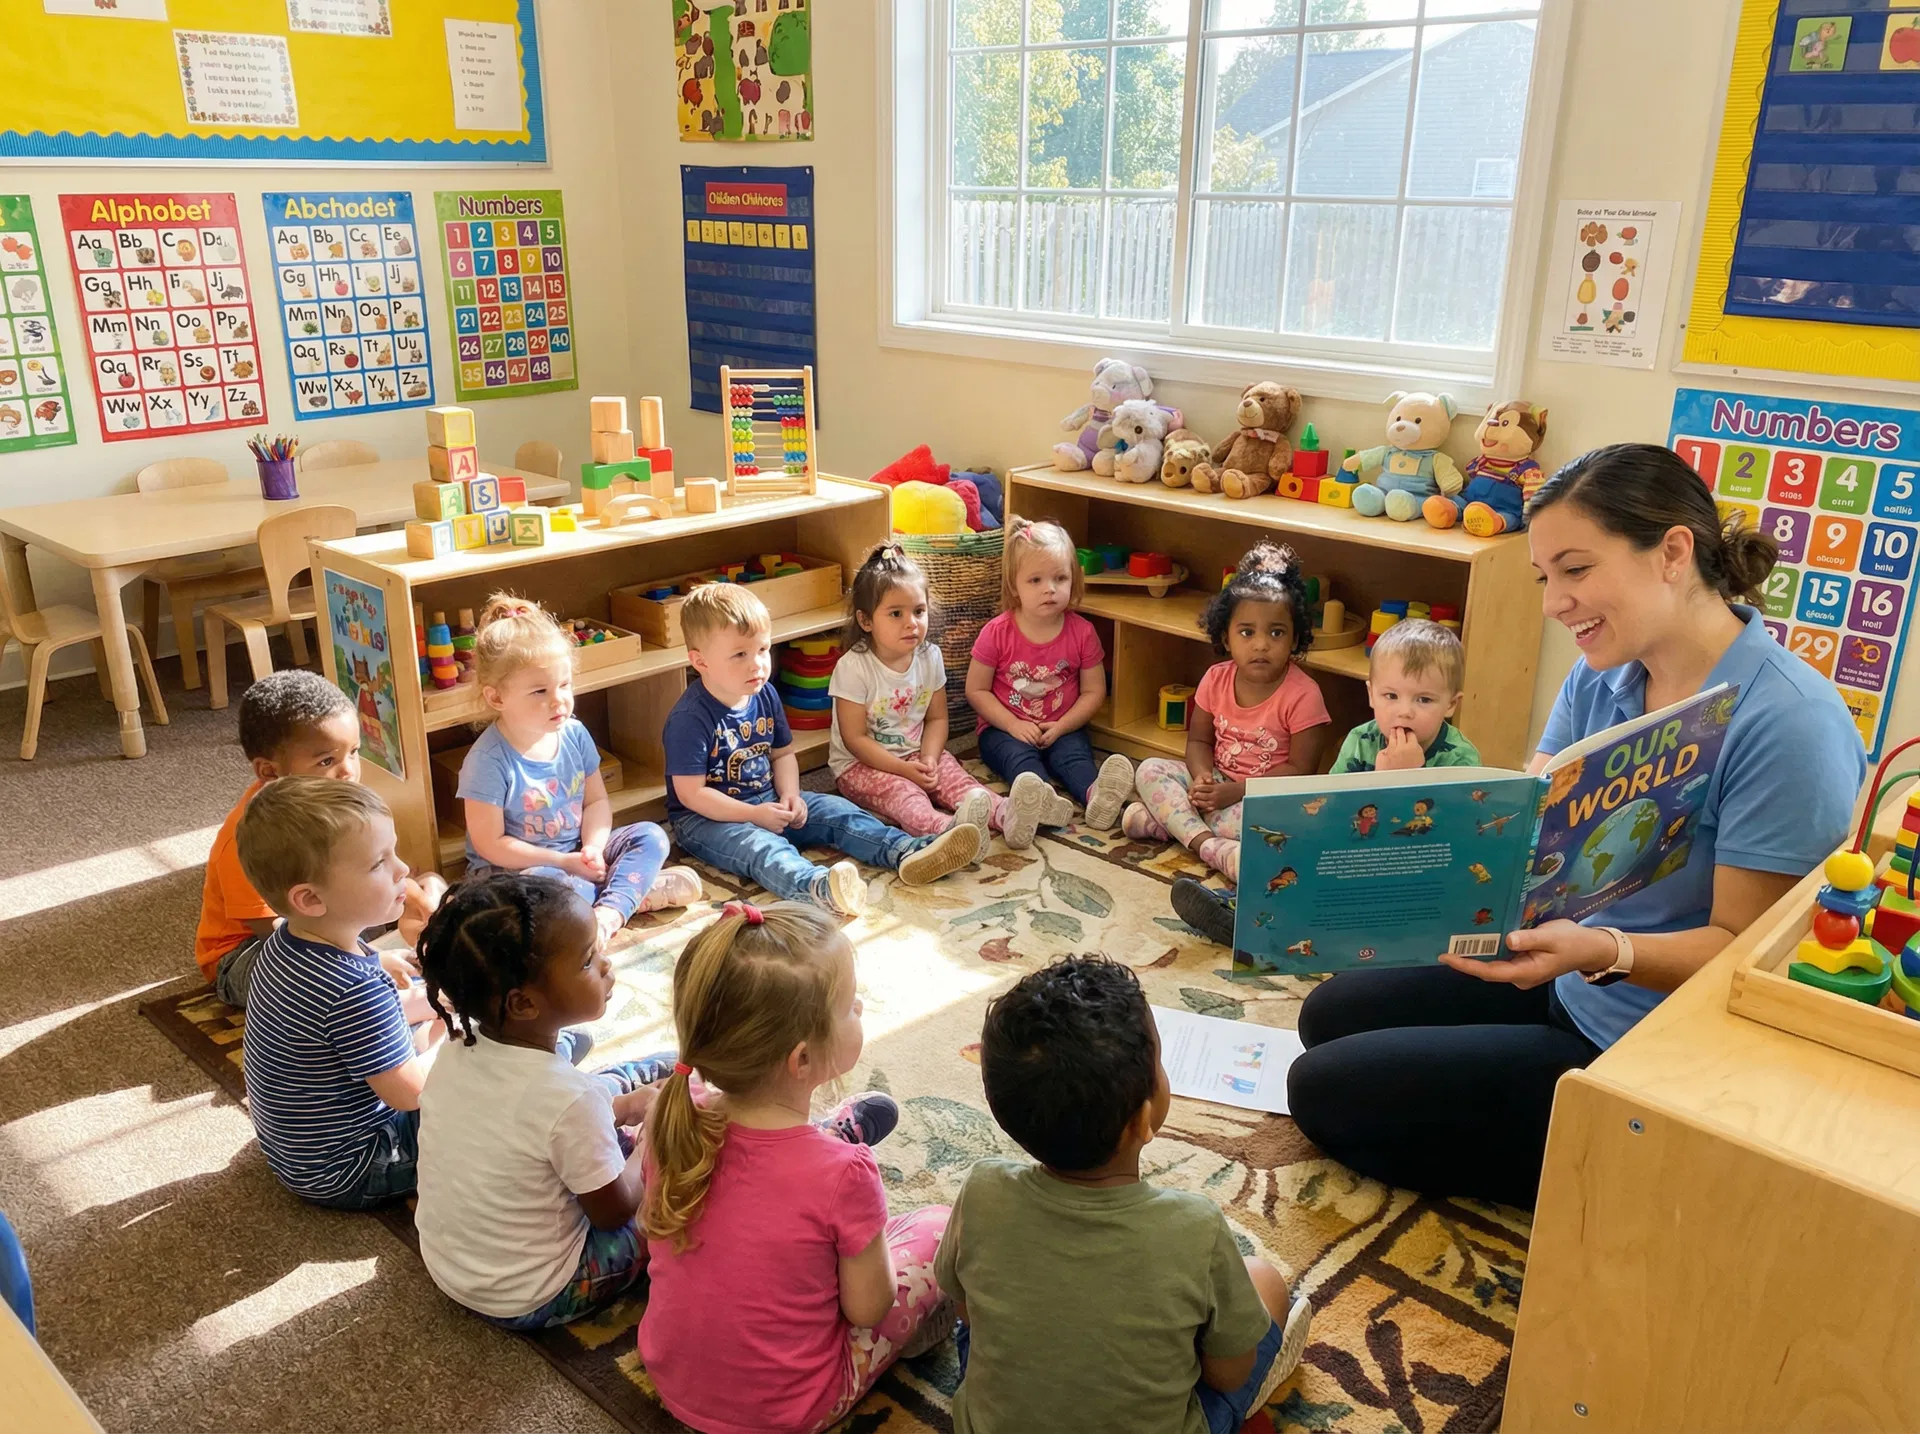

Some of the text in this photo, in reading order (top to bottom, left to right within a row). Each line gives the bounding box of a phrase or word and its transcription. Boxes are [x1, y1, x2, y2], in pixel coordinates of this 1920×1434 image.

[91, 198, 212, 228] Alphobet
[284, 196, 396, 220] Abchodet
[457, 195, 544, 217] Numbers
[78, 234, 102, 250] Aa
[118, 233, 142, 248] Bb
[162, 232, 176, 247] C
[278, 227, 401, 244] Aa Bb Cc Ee
[454, 225, 555, 244] 1 2 3 4 5
[718, 228, 722, 237] 3
[748, 230, 752, 239] 5
[762, 230, 768, 240] 6
[456, 252, 560, 272] 6 7 8 9 10
[84, 277, 112, 296] Gg
[127, 275, 153, 290] Hh
[210, 272, 224, 292] Jj
[283, 269, 306, 287] Gg
[319, 268, 340, 282] Hh
[390, 264, 401, 284] Jj
[458, 280, 562, 300] 11 12 13 14 15
[93, 311, 237, 333] Mm Nn Oo Pp
[288, 301, 402, 322] Mm Nn Oo P
[460, 306, 566, 328] 21 22 23 24 25
[293, 344, 320, 361] Qq
[364, 339, 378, 352] Tt
[397, 337, 416, 350] Uu
[461, 333, 569, 356] 26 27 28 29 40
[100, 350, 239, 375] Qq Rr Ss Tt
[464, 361, 549, 382] 35 46 47 48
[298, 372, 419, 395] Ww Xx Yy Zz
[106, 388, 248, 414] Ww Xx Yy Zz
[1713, 399, 1900, 450] Numbers
[456, 454, 472, 475] A
[1691, 446, 1916, 500] 1 2 3 4 5
[478, 485, 491, 505] S
[493, 518, 506, 536] U
[1773, 515, 1795, 542] 8
[1826, 522, 1847, 549] 9
[1872, 529, 1909, 559] 10
[1810, 578, 1842, 606] 15
[1861, 586, 1894, 616] 16
[1792, 632, 1833, 661] 29
[1604, 719, 1682, 779] OUR
[1568, 743, 1700, 828] WORLD
